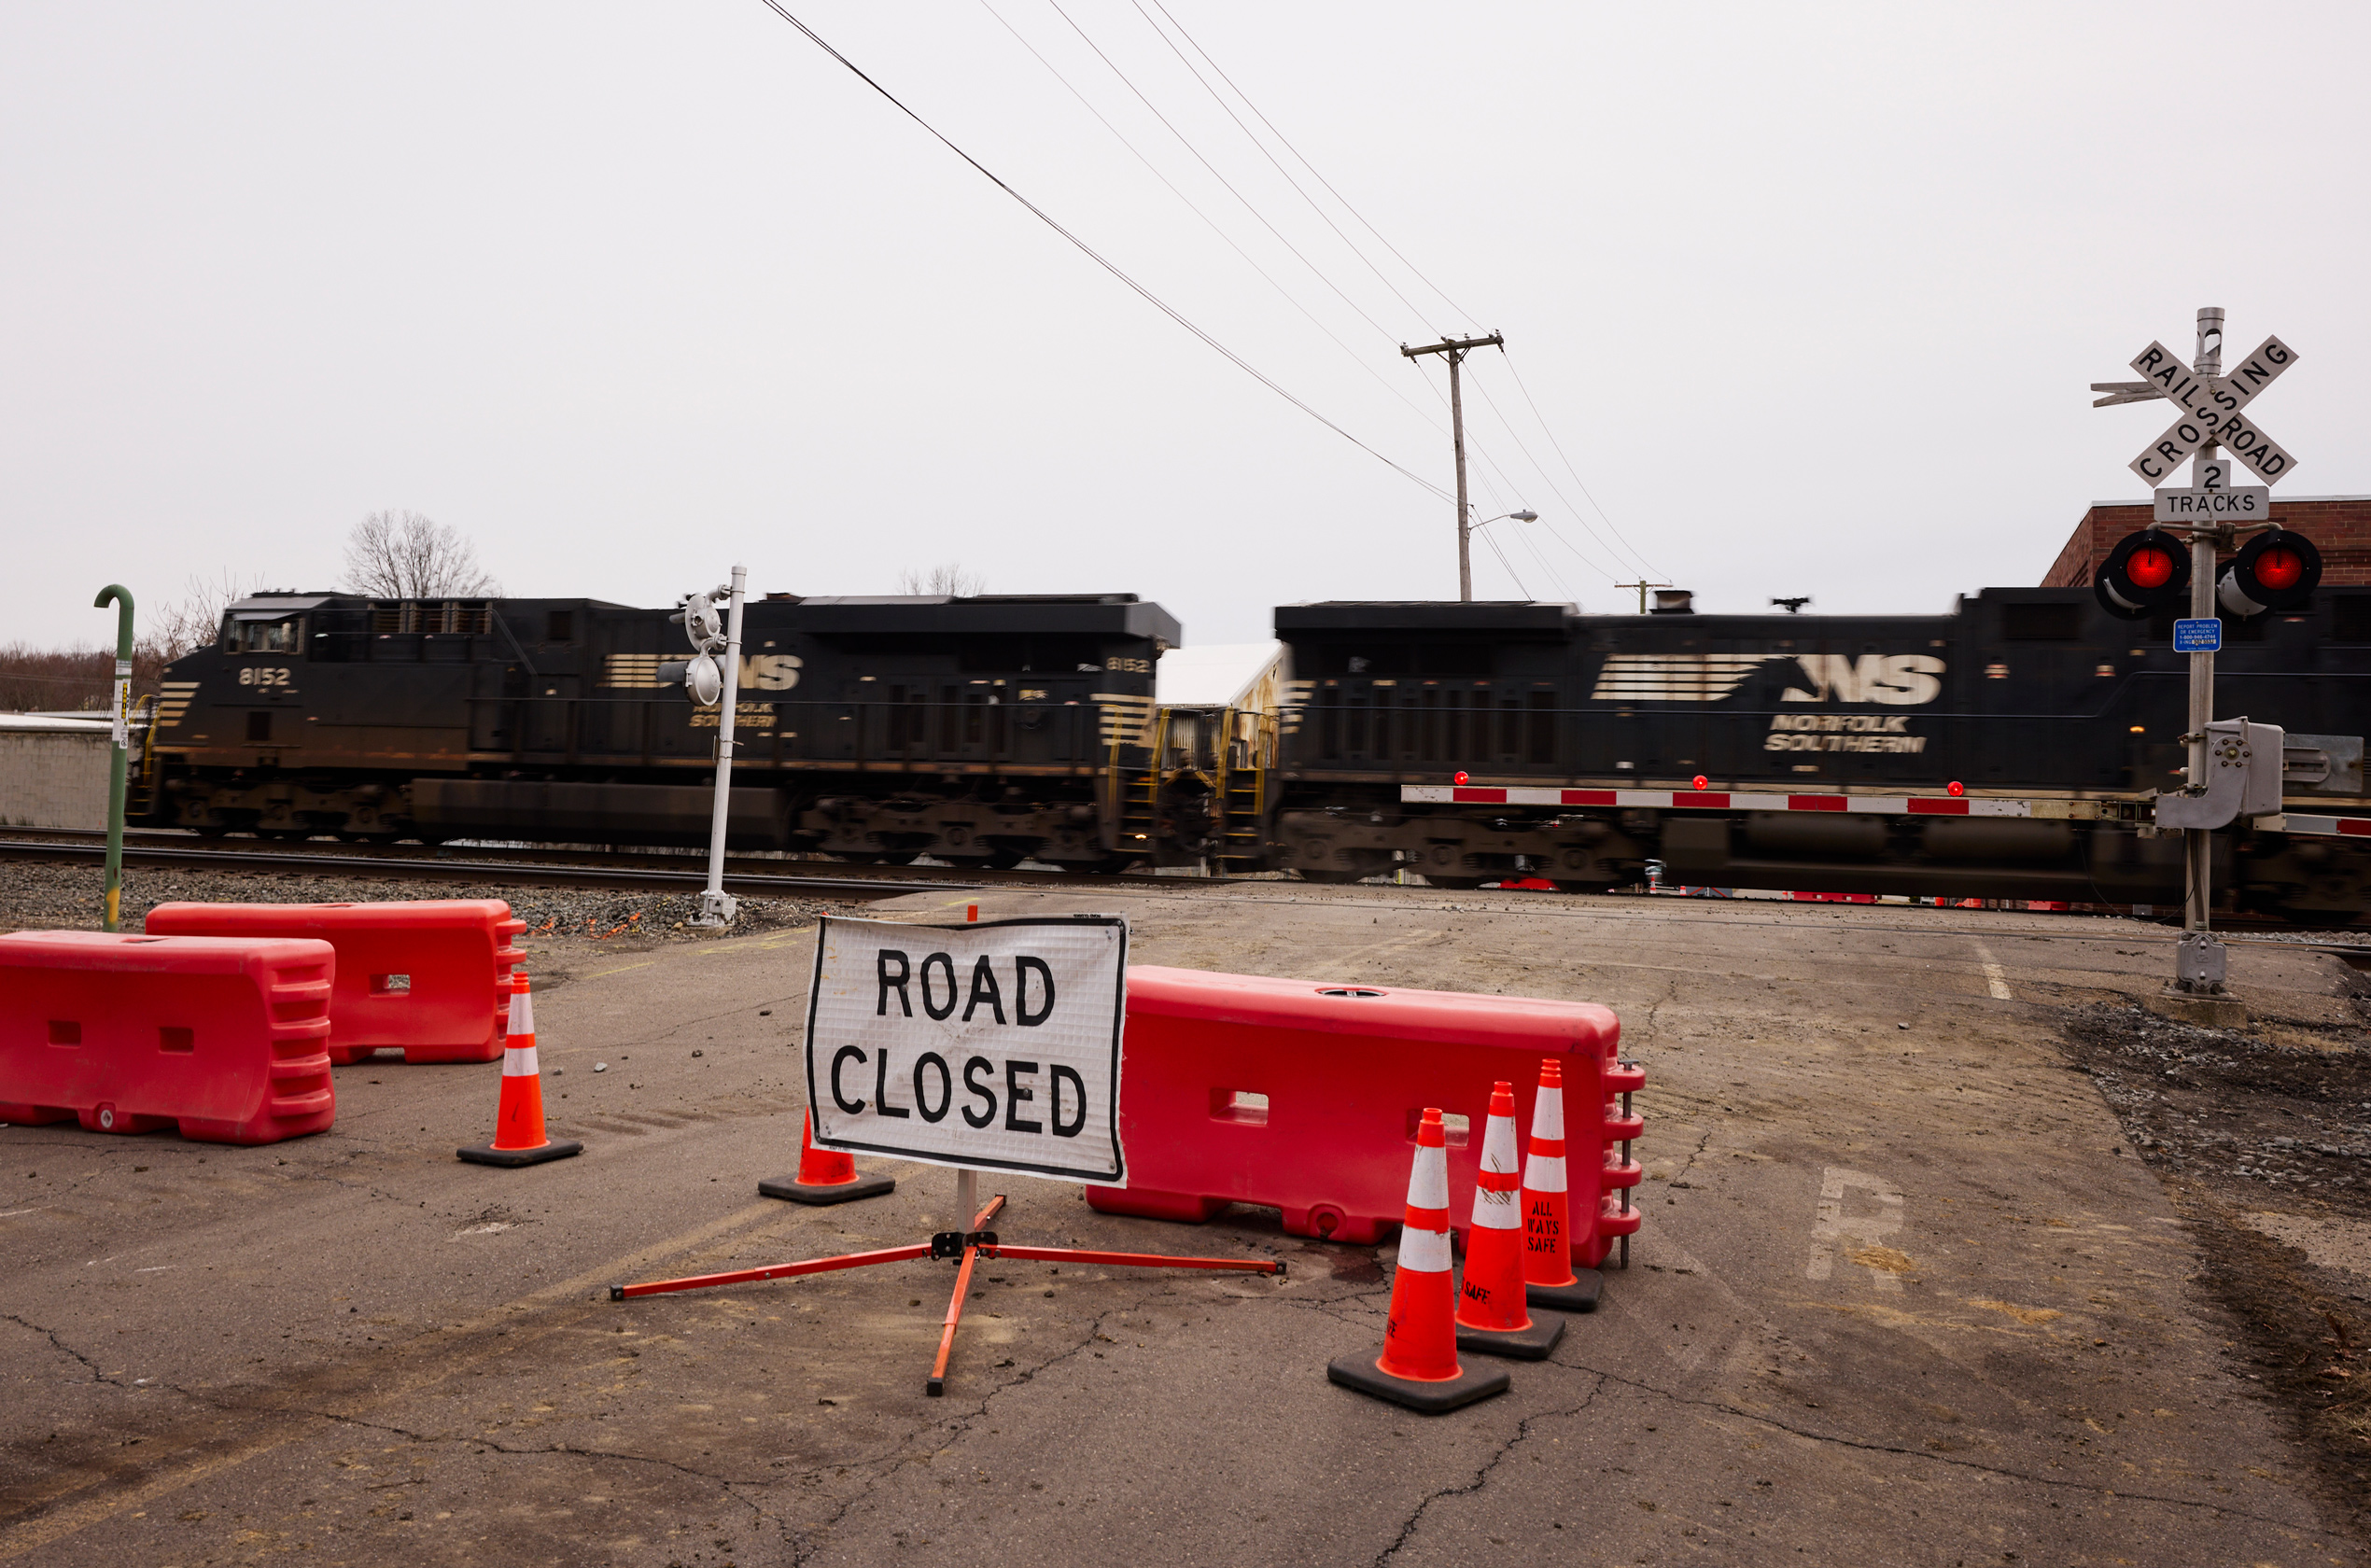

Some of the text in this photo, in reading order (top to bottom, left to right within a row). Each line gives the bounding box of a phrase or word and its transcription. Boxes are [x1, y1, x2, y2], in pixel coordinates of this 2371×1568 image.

[2139, 348, 2285, 475] RAIL ROAD
[2140, 344, 2289, 478] CROSSING
[2204, 467, 2221, 488] 2
[2168, 495, 2255, 512] TRACKS
[1106, 656, 1151, 673] 8152
[239, 667, 291, 685] 8152
[1781, 654, 1946, 705] NS
[1769, 715, 1911, 733] NORFOLK
[1763, 734, 1927, 753] SOUTHERN
[877, 948, 1056, 1027] ROAD
[831, 1044, 1087, 1138] CLOSED
[1532, 1200, 1552, 1216] ALL
[1527, 1218, 1559, 1235] WAYS
[1527, 1236, 1556, 1253] SAFE
[1465, 1281, 1491, 1305] SAFE
